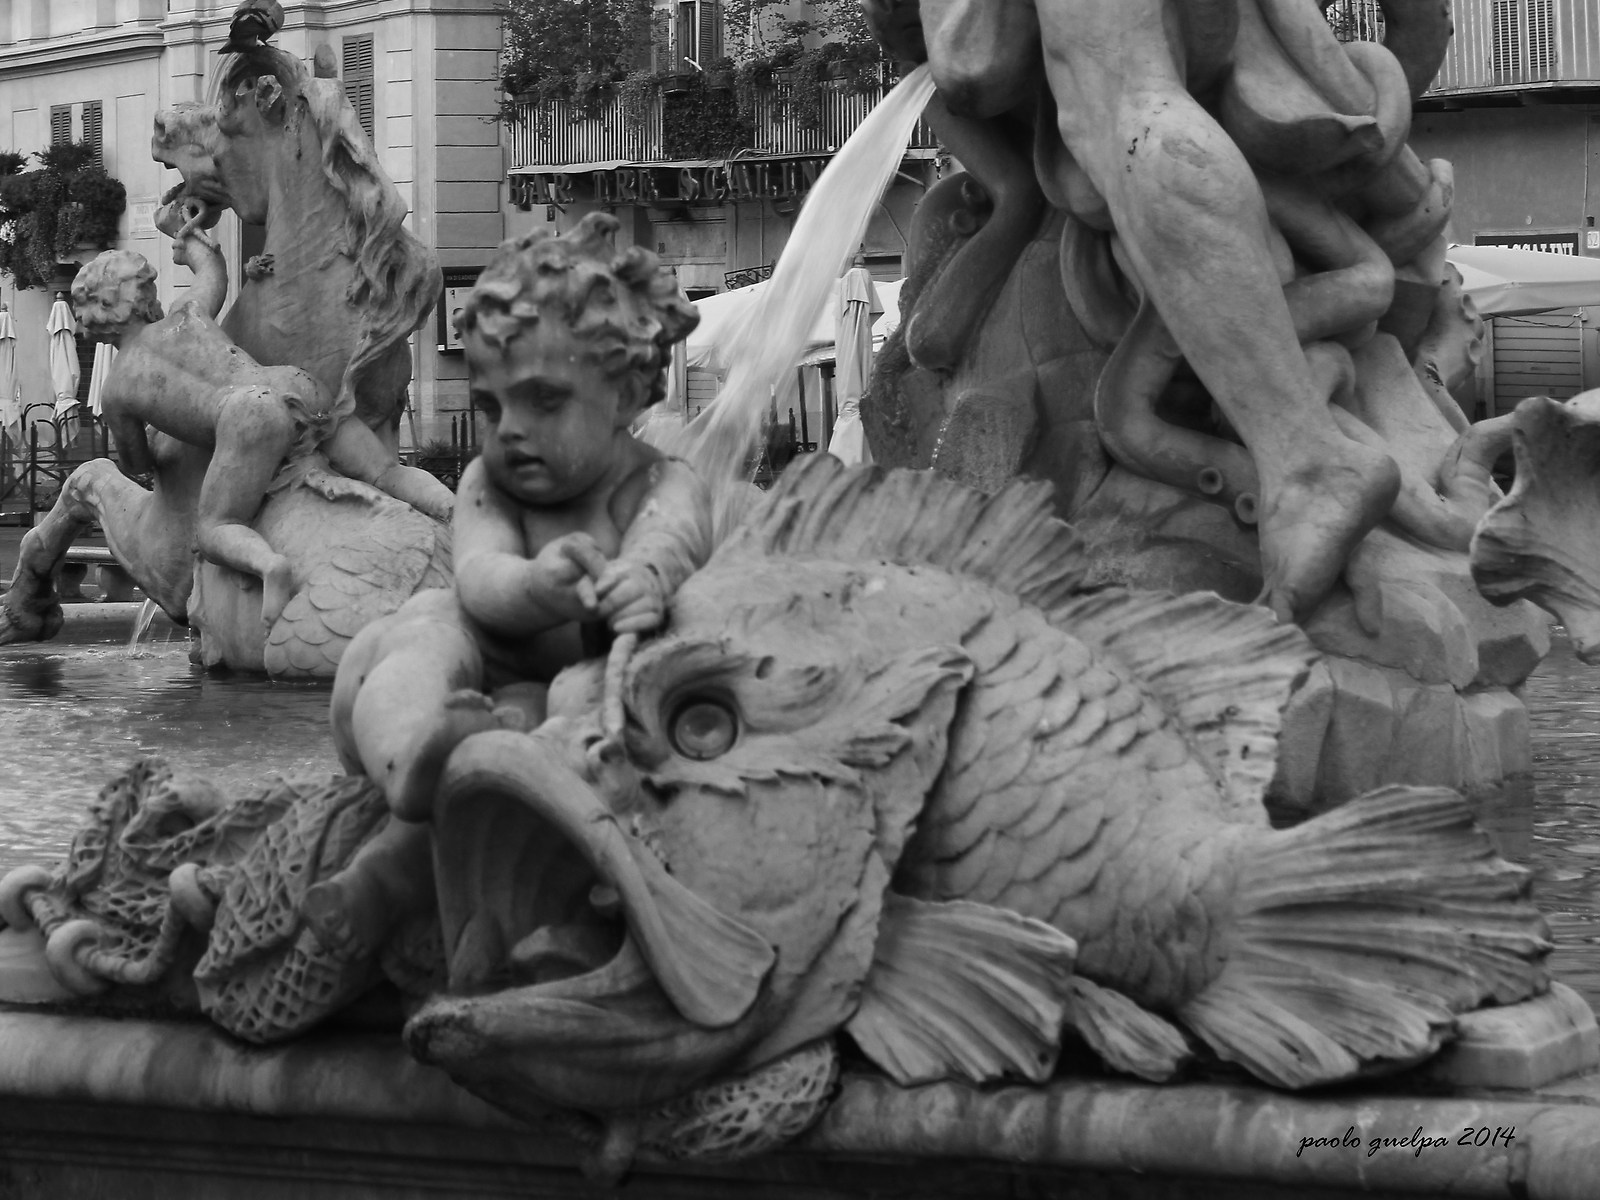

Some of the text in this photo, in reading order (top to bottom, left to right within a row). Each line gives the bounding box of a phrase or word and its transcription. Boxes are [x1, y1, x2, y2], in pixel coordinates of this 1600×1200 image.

[509, 160, 836, 205] BAR TRE SCALIN
